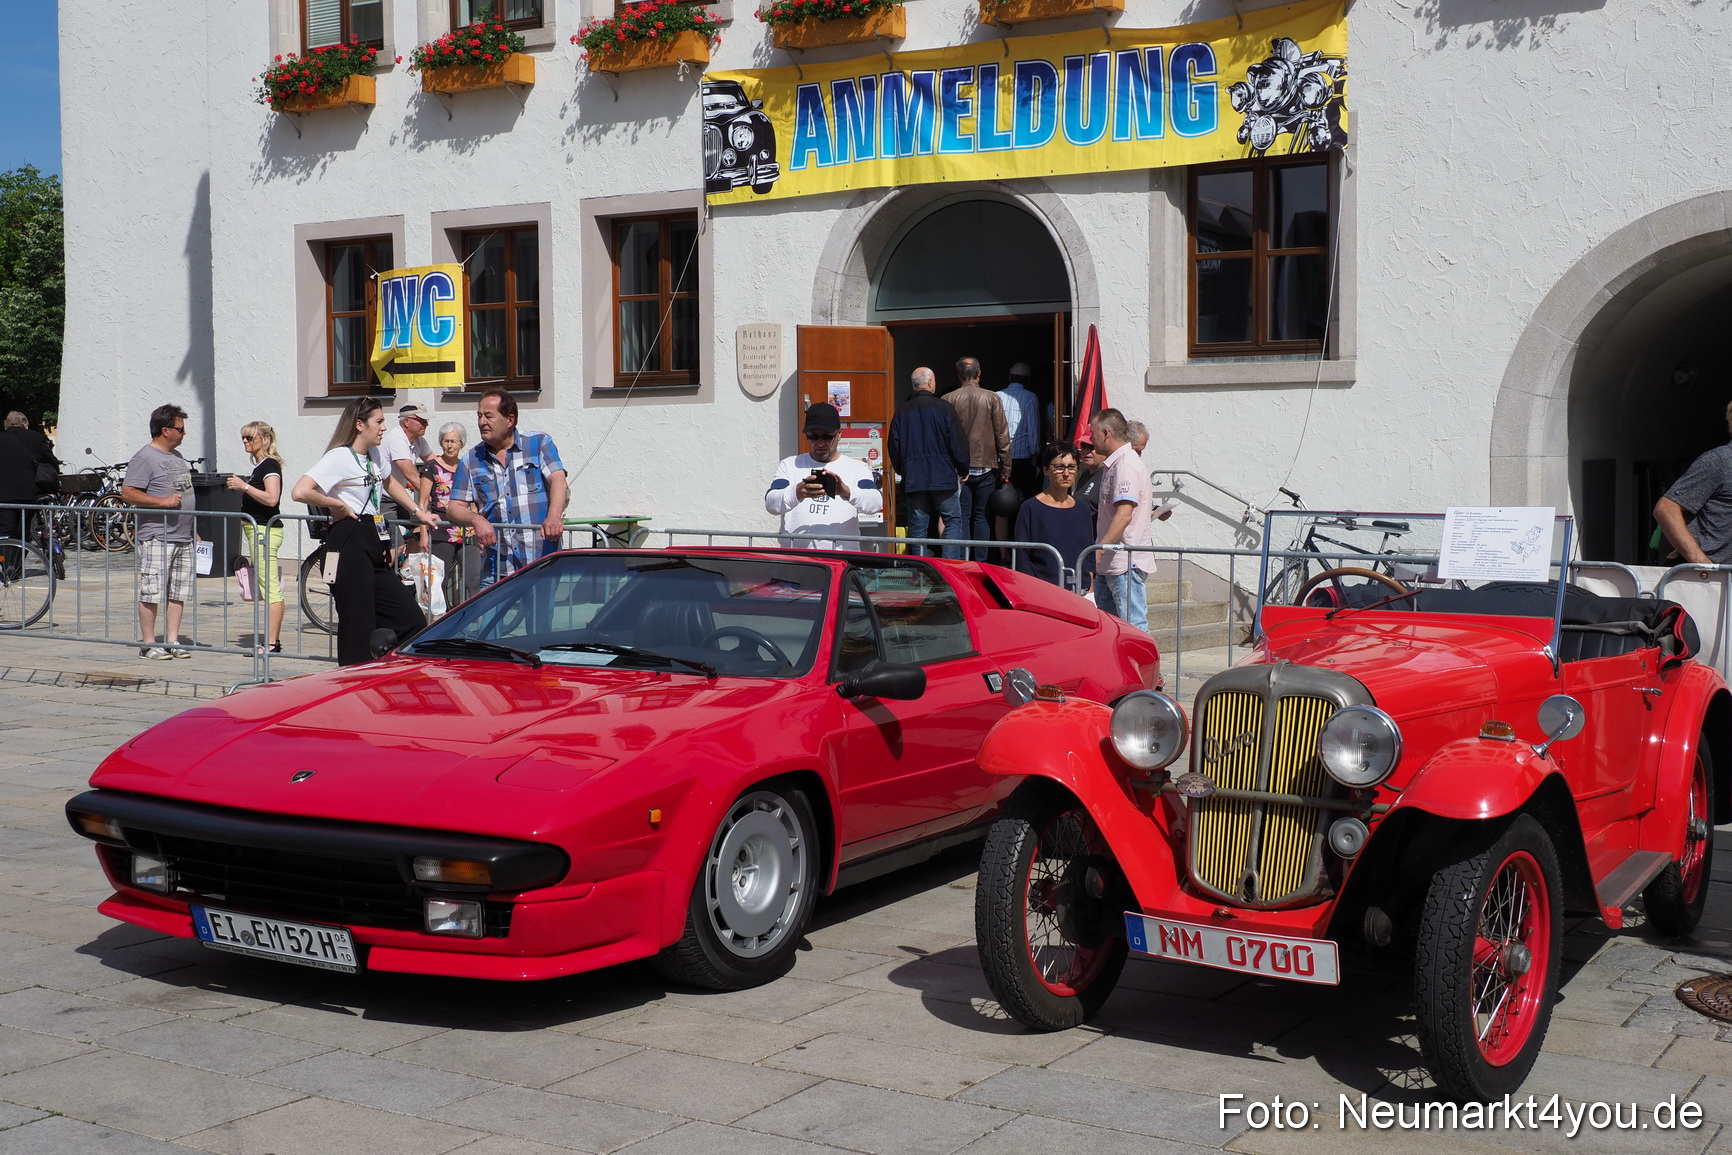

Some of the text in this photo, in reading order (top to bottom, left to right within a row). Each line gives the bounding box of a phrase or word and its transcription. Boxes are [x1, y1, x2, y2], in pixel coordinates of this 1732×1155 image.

[789, 42, 1218, 171] ANMELDUNG
[381, 271, 456, 351] WC
[743, 330, 776, 338] Rathaus
[808, 503, 829, 514] OFF
[1204, 731, 1255, 763] Aero
[201, 926, 208, 935] D
[209, 912, 241, 943] EI
[334, 934, 347, 943] 05
[1133, 936, 1141, 946] D
[1158, 924, 1315, 976] NM 0700
[341, 952, 352, 962] 10
